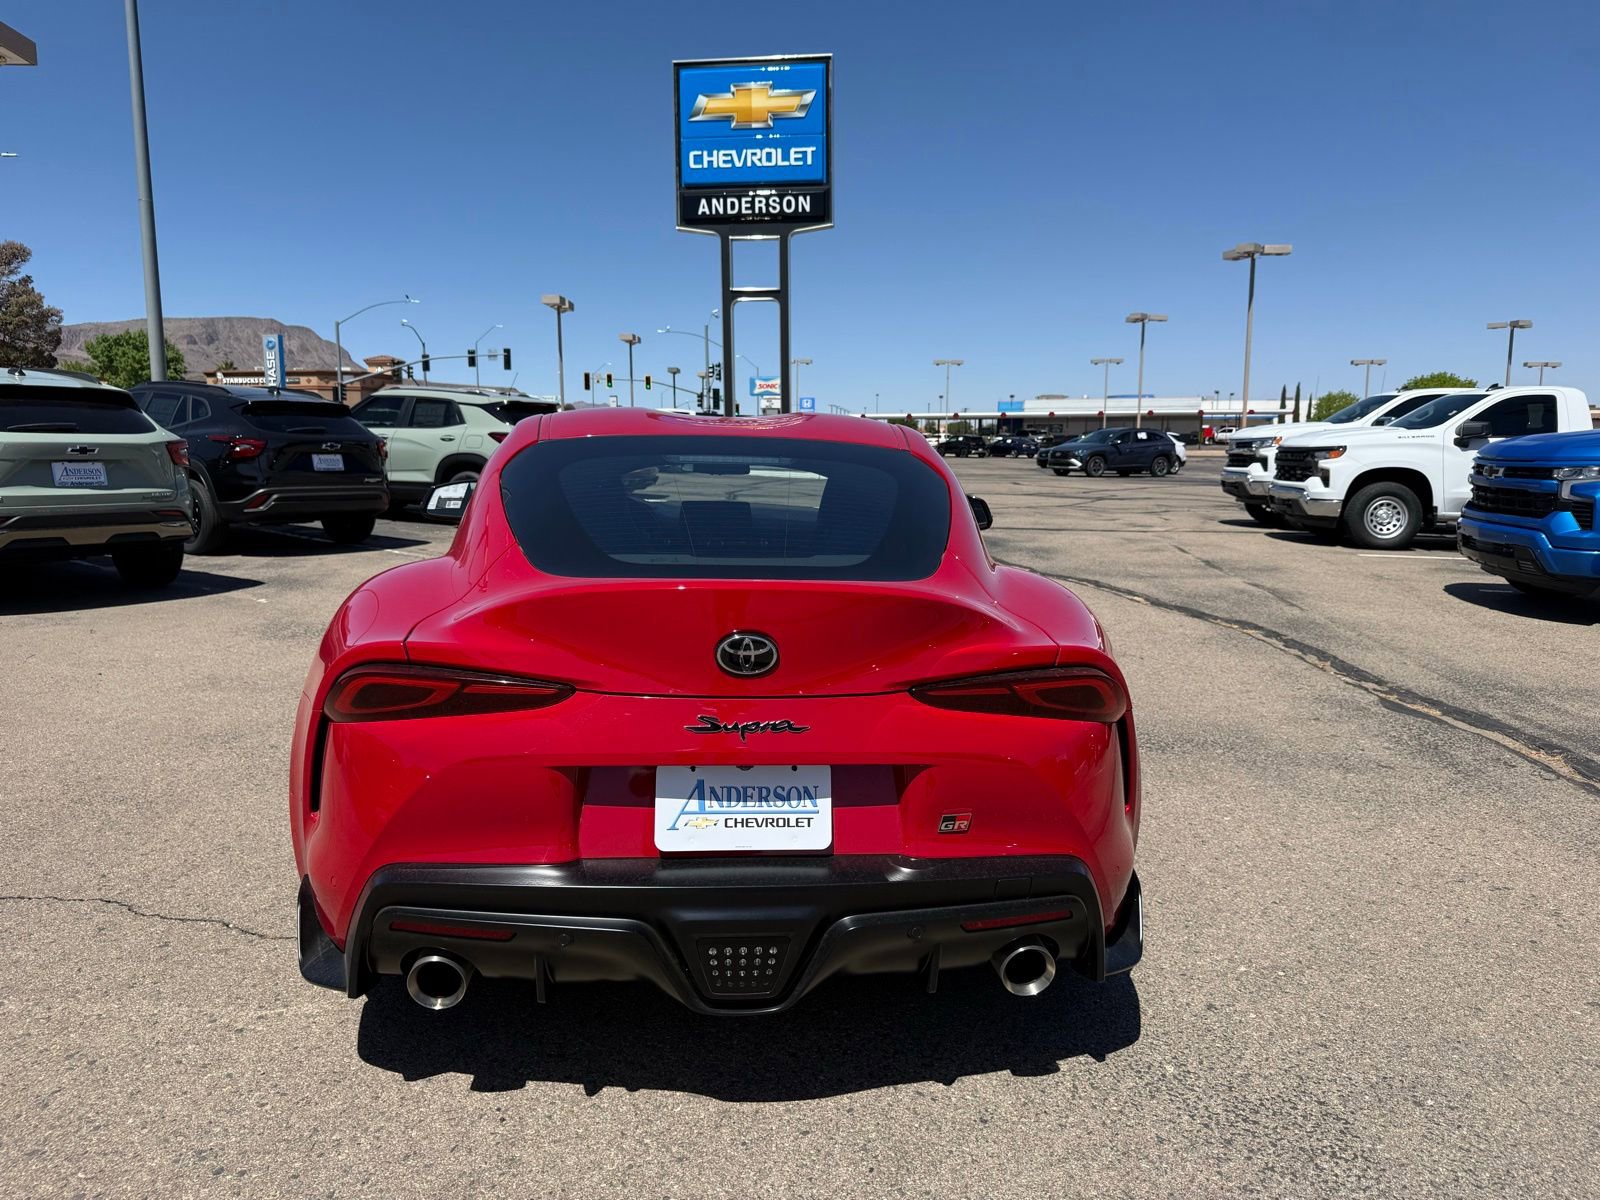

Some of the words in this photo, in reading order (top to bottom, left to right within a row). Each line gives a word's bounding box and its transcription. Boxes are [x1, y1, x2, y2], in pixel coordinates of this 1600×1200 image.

[689, 147, 816, 168] CHEVROLET
[698, 195, 811, 215] ANDERSON
[266, 351, 277, 387] HASE
[222, 377, 259, 385] STARBUCKS
[59, 466, 103, 480] ANDERSON
[684, 714, 811, 743] Supra
[666, 779, 820, 831] ANDERSON
[724, 817, 815, 828] CHEVROLET
[940, 820, 968, 831] GR
